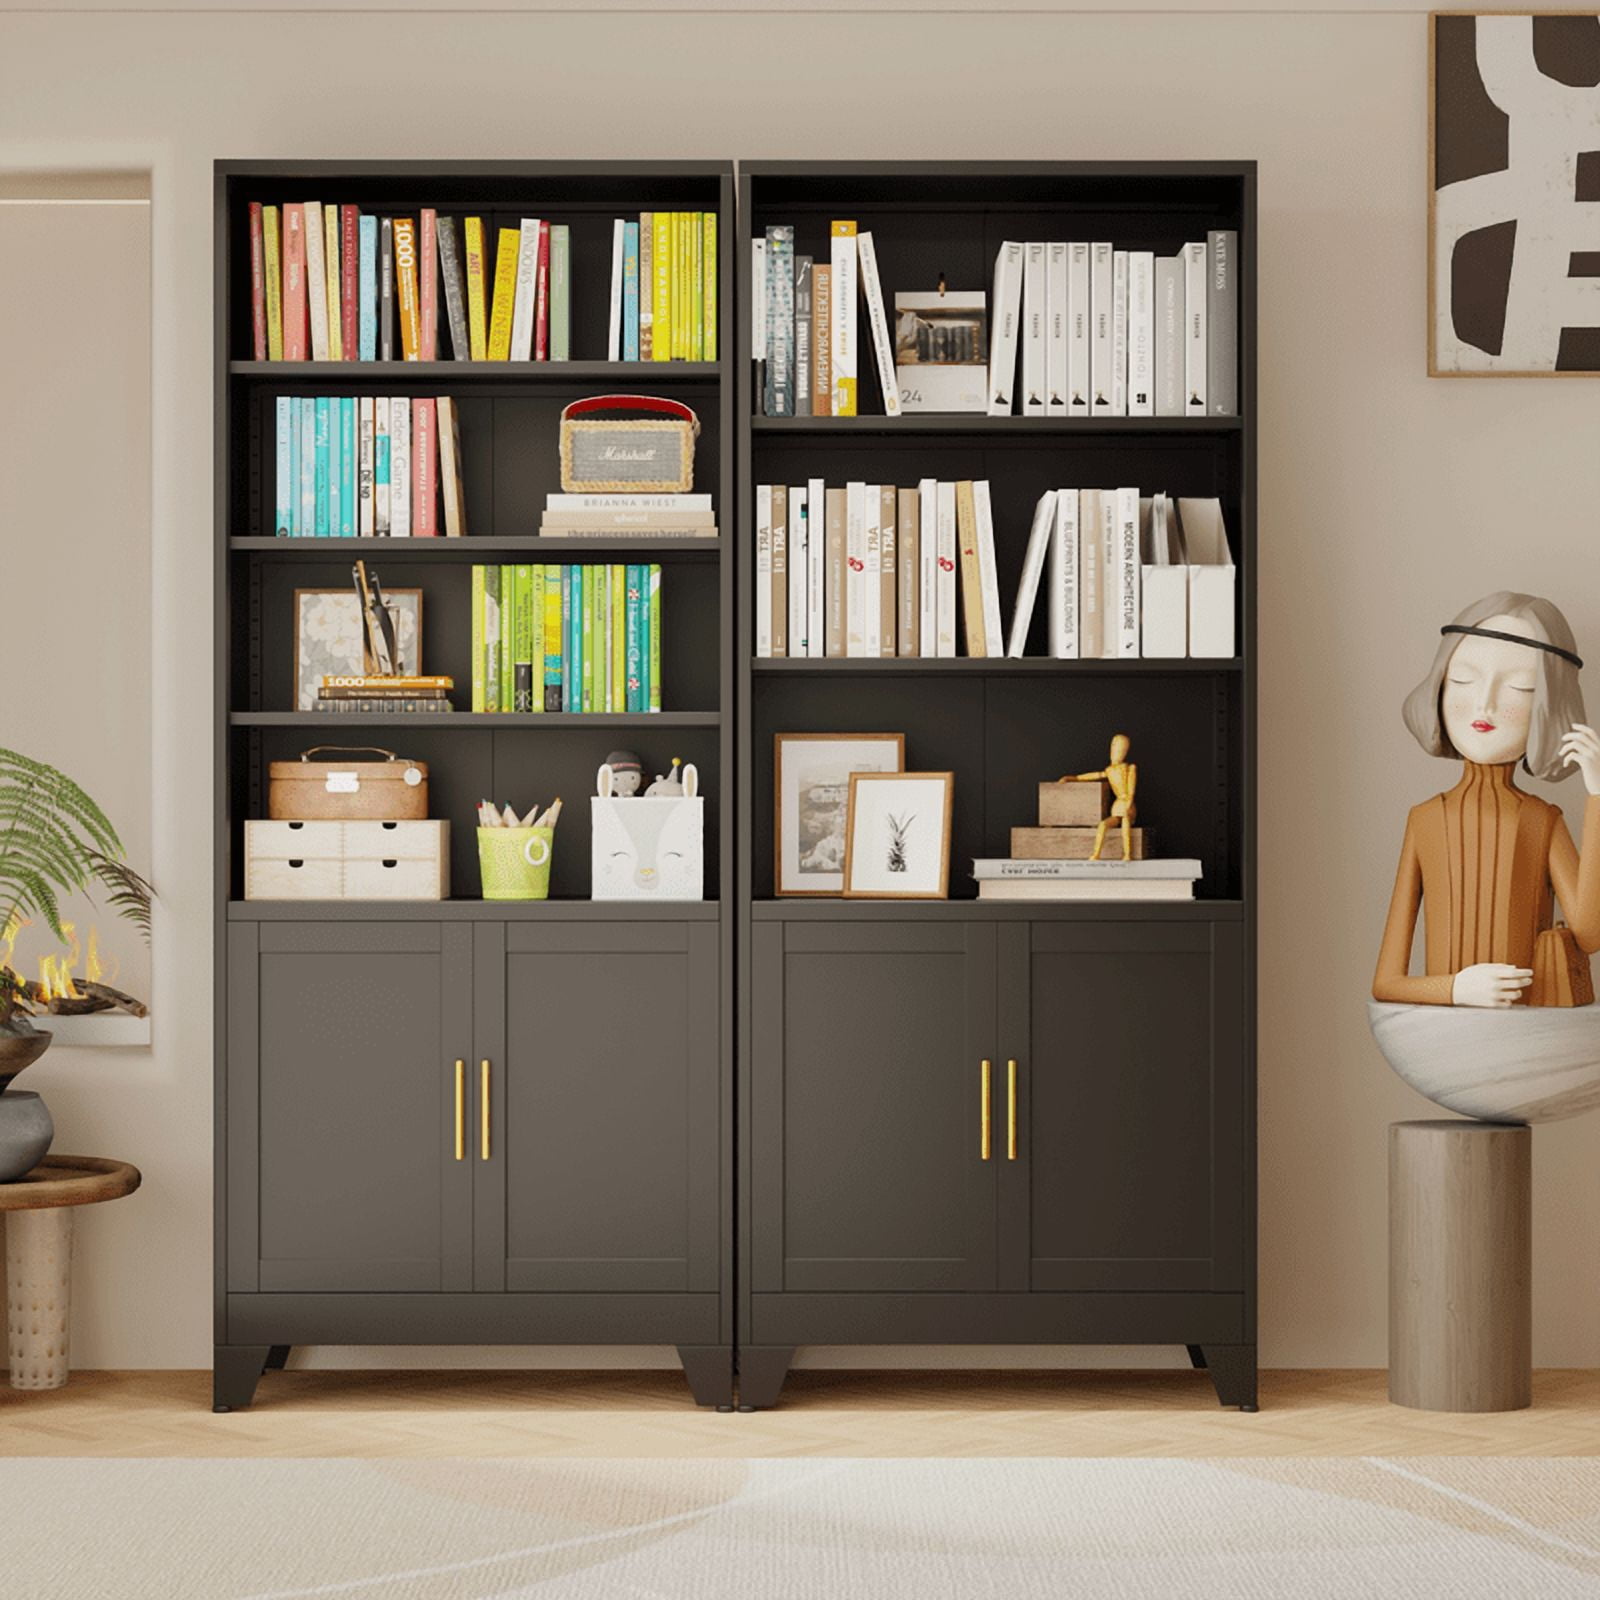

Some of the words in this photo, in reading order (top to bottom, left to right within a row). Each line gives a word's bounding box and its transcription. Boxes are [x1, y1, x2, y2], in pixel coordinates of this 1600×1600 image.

[396, 222, 414, 268] 1000
[520, 223, 537, 285] WINDOWS
[1215, 233, 1226, 260] KATE
[1215, 262, 1226, 290] MOSS
[900, 389, 922, 403] 24
[393, 400, 406, 453] Ender's
[598, 446, 657, 461] Marshall
[393, 457, 406, 500] Game
[584, 498, 637, 507] BRIANNA
[642, 498, 678, 507] WIEST
[1064, 521, 1074, 576] BLUEPRINTS
[1124, 521, 1134, 561] MODERN
[1064, 586, 1074, 634] BUILDINGS
[1124, 562, 1134, 630] ARCHITECTURE
[327, 677, 365, 687] 1000
